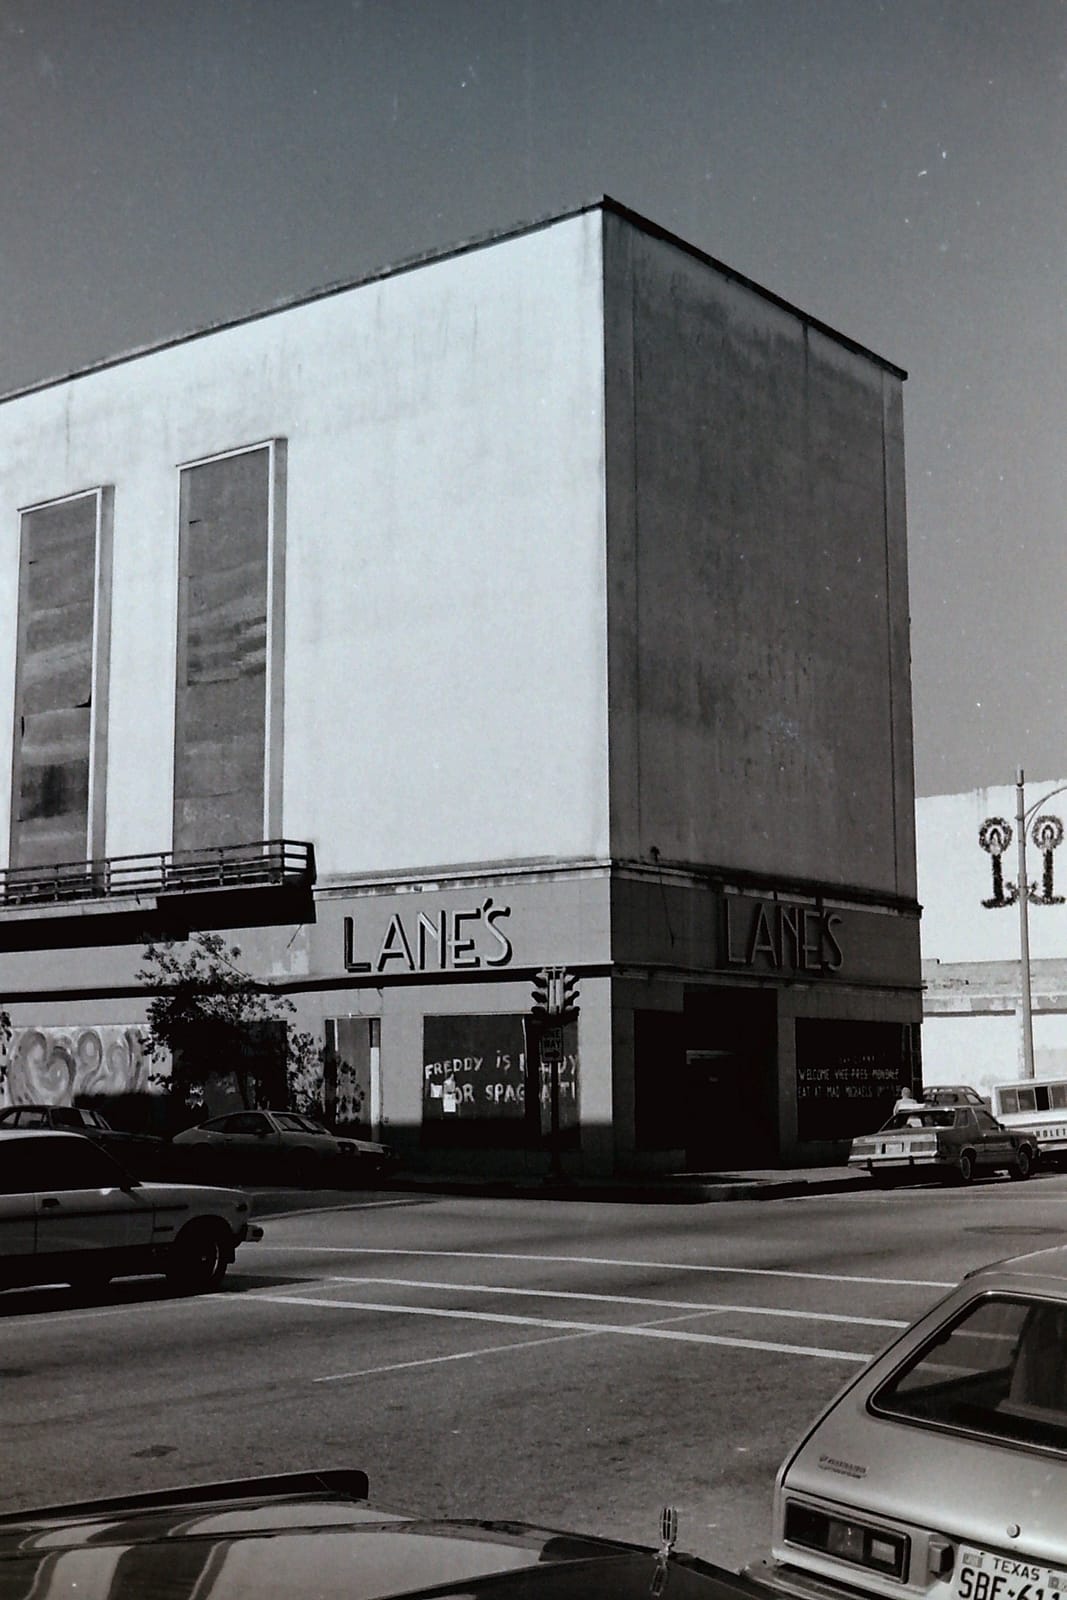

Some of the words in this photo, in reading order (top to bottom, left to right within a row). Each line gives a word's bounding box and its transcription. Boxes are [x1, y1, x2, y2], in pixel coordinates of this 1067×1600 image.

[343, 898, 513, 973] LANE'S
[725, 898, 844, 972] LANE'S
[543, 1039, 561, 1049] WAY
[424, 1057, 484, 1080] FREDDY
[798, 1068, 831, 1080] WELCOME
[993, 1556, 1040, 1581] TEXAS
